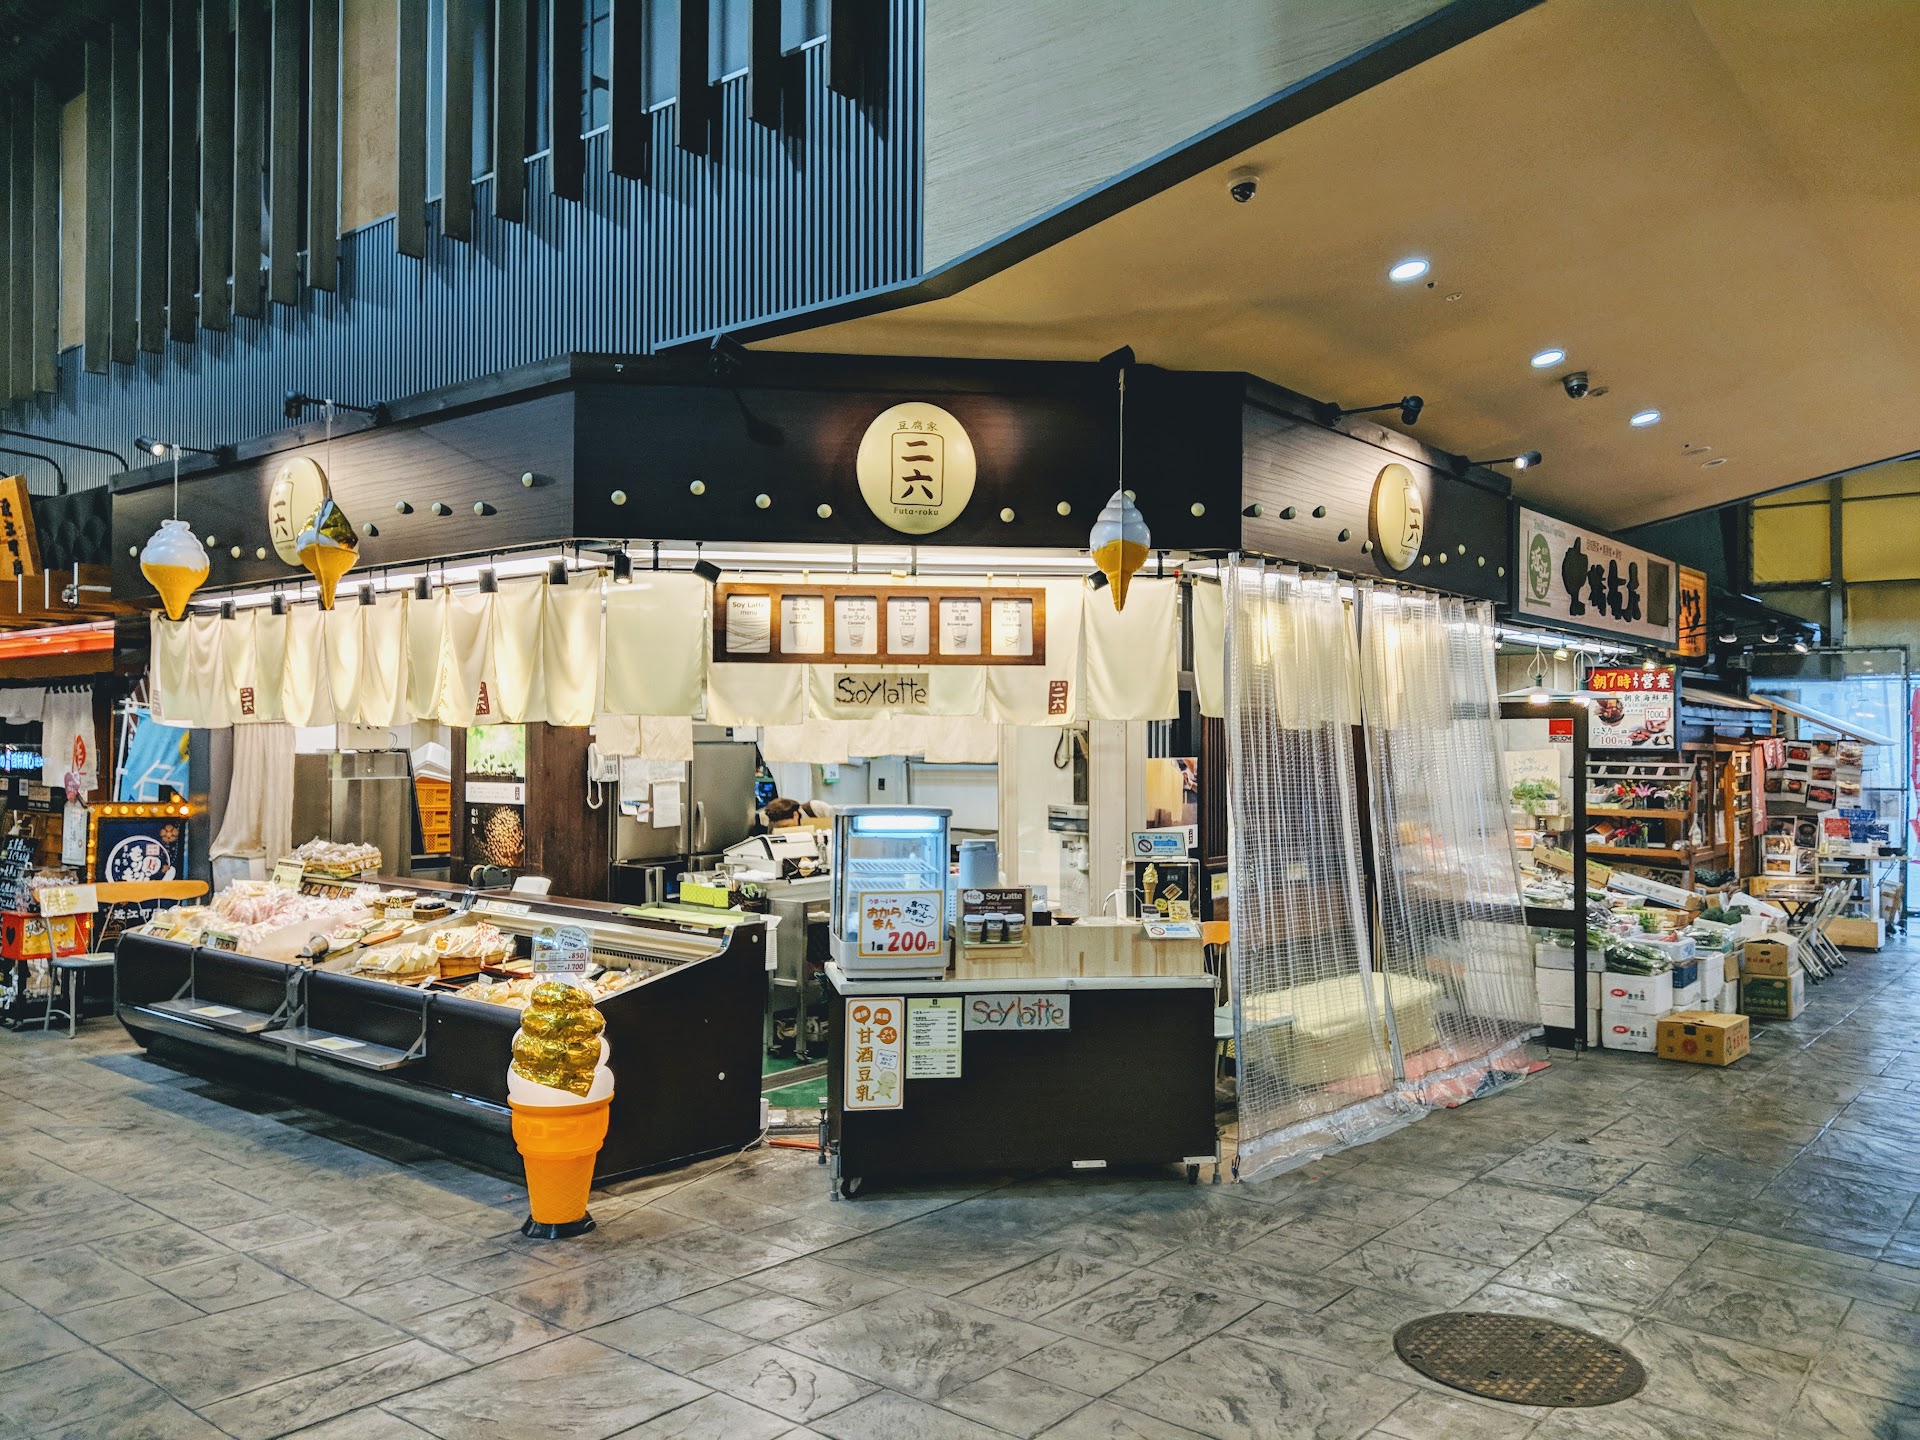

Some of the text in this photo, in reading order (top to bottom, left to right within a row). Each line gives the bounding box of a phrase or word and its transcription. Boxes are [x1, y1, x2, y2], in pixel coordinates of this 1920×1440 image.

[897, 420, 938, 431] 豆腐家
[901, 440, 934, 500] 二六
[985, 892, 1001, 901] Soy
[1002, 892, 1023, 900] Latte
[867, 907, 902, 919] おから
[873, 918, 896, 931] まん
[888, 931, 936, 952] 200円
[855, 1026, 875, 1103] 甘酒豆乳
